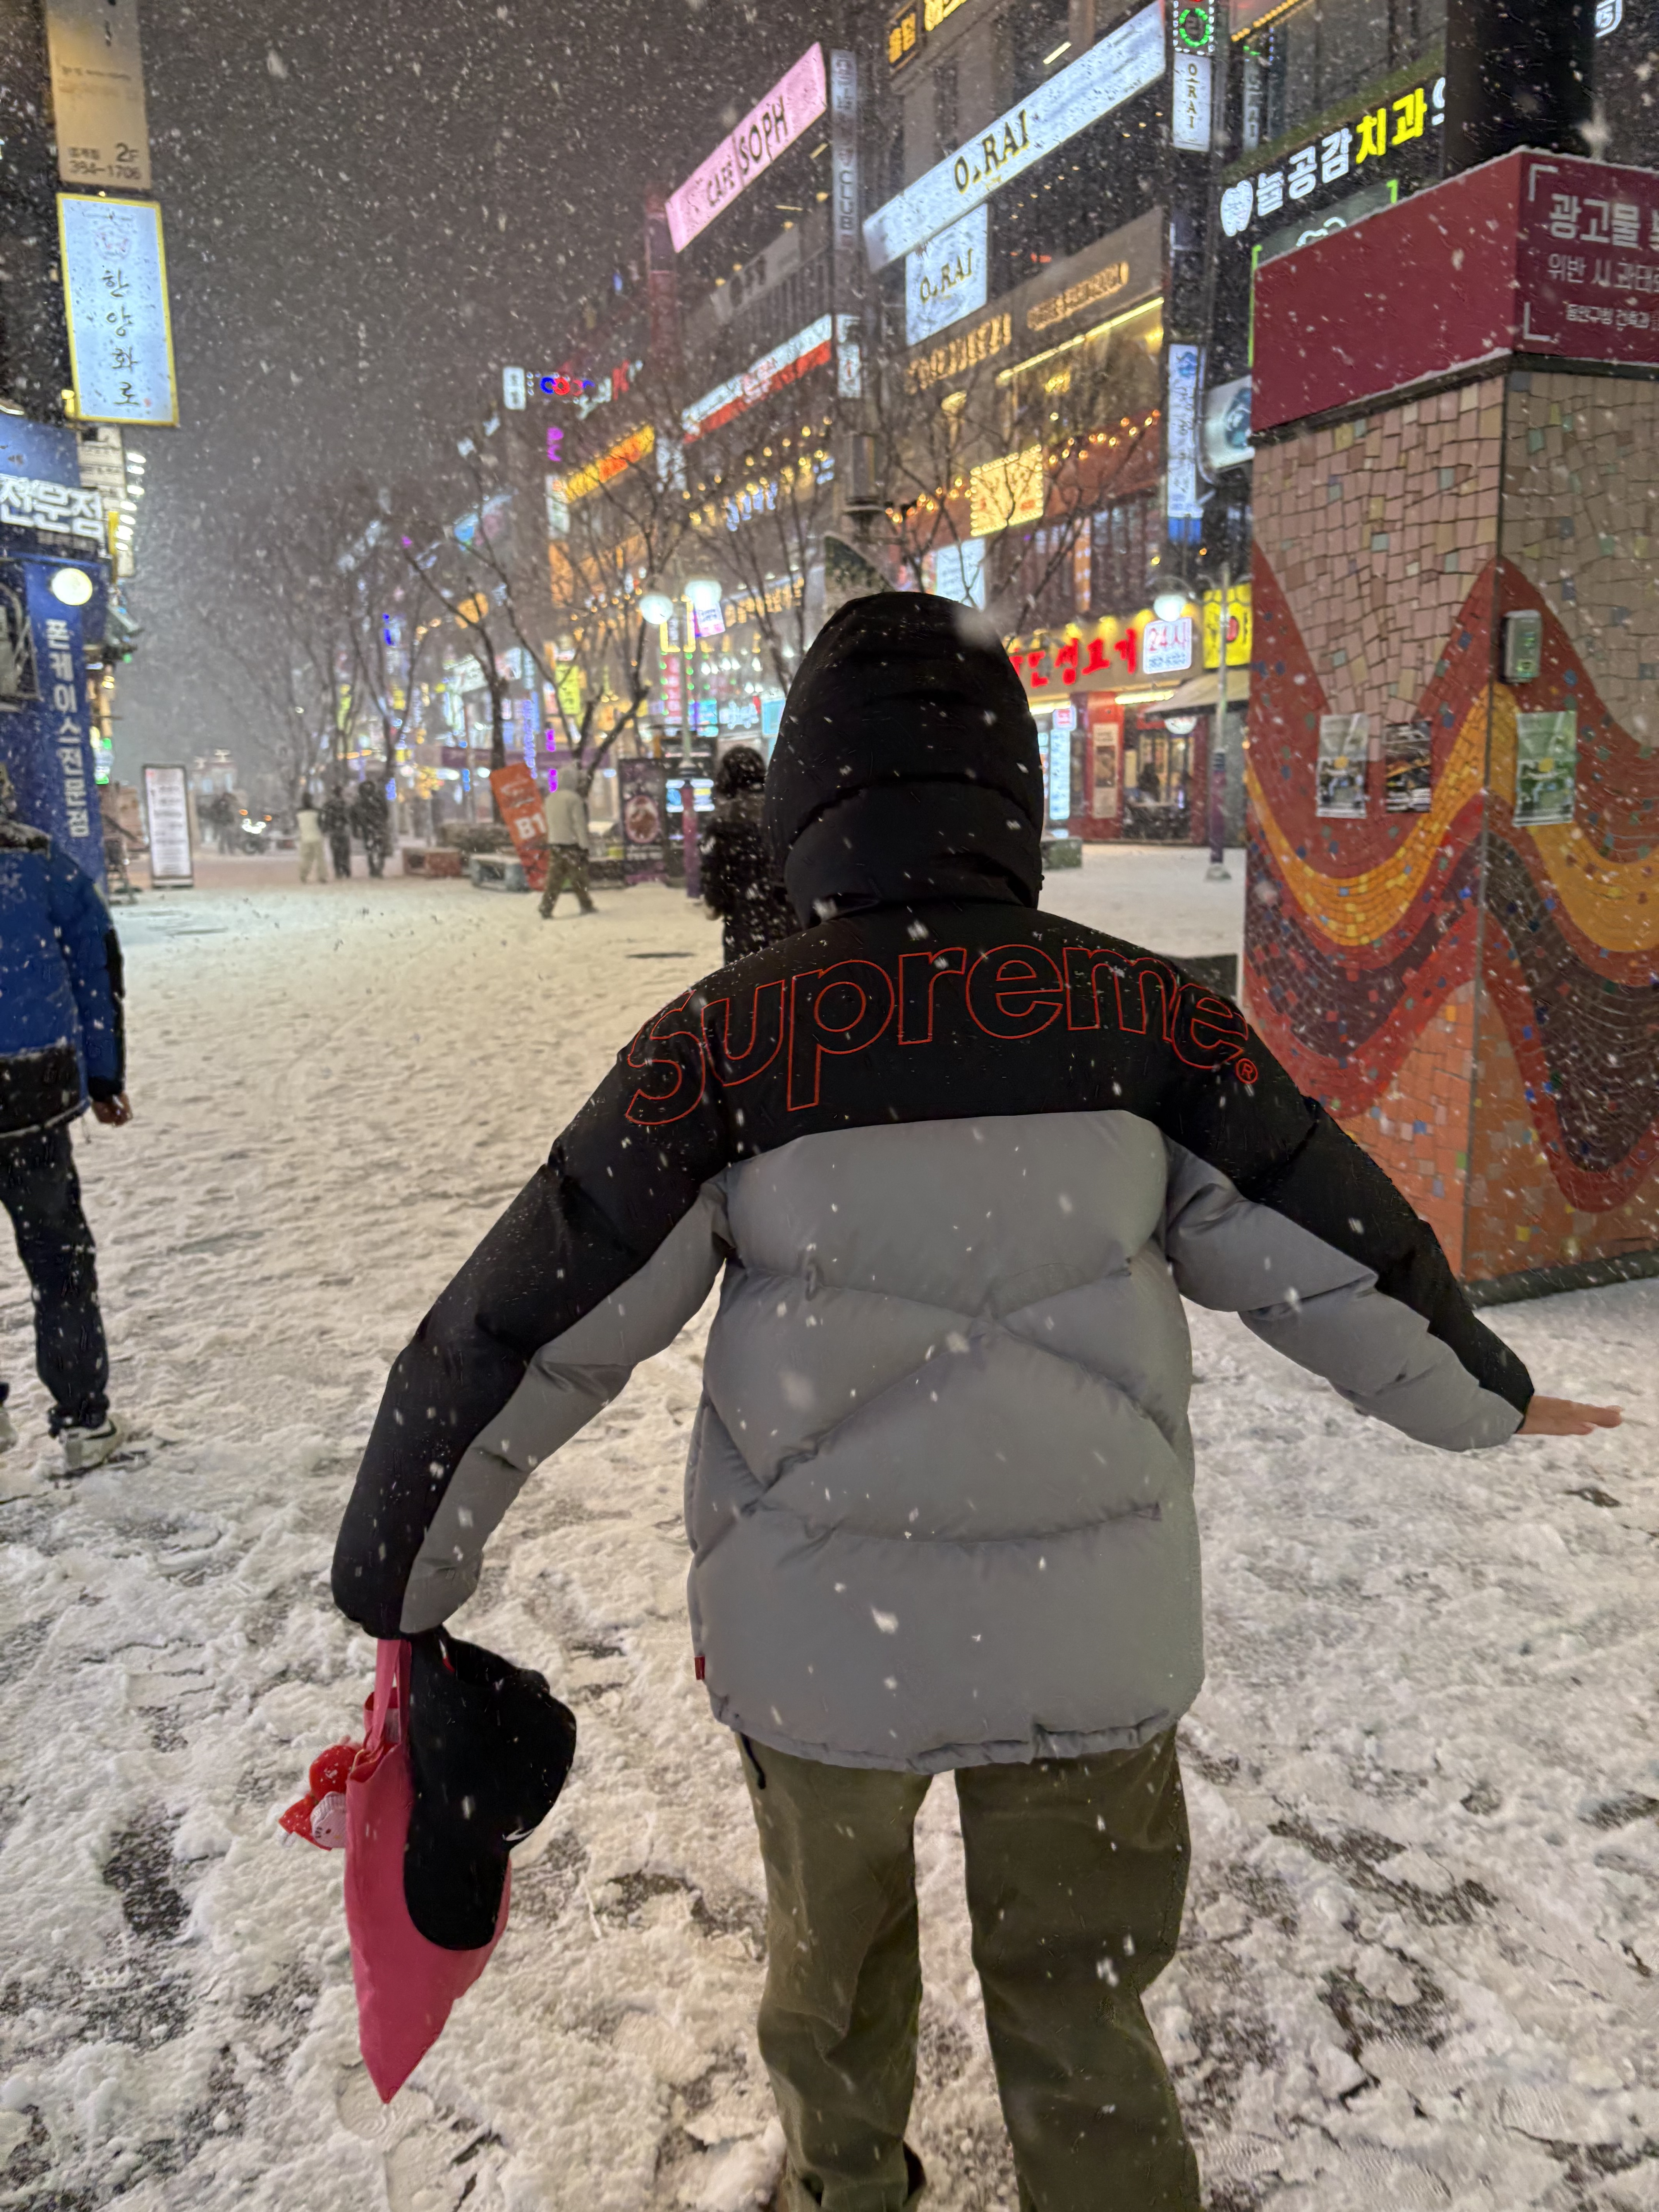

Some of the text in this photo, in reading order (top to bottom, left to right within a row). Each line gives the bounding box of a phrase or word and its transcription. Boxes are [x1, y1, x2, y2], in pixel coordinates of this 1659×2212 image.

[1549, 193, 1641, 249] 광고물
[1547, 253, 1587, 284] 위반
[1590, 258, 1611, 287] 시
[0, 472, 105, 540] 전문점
